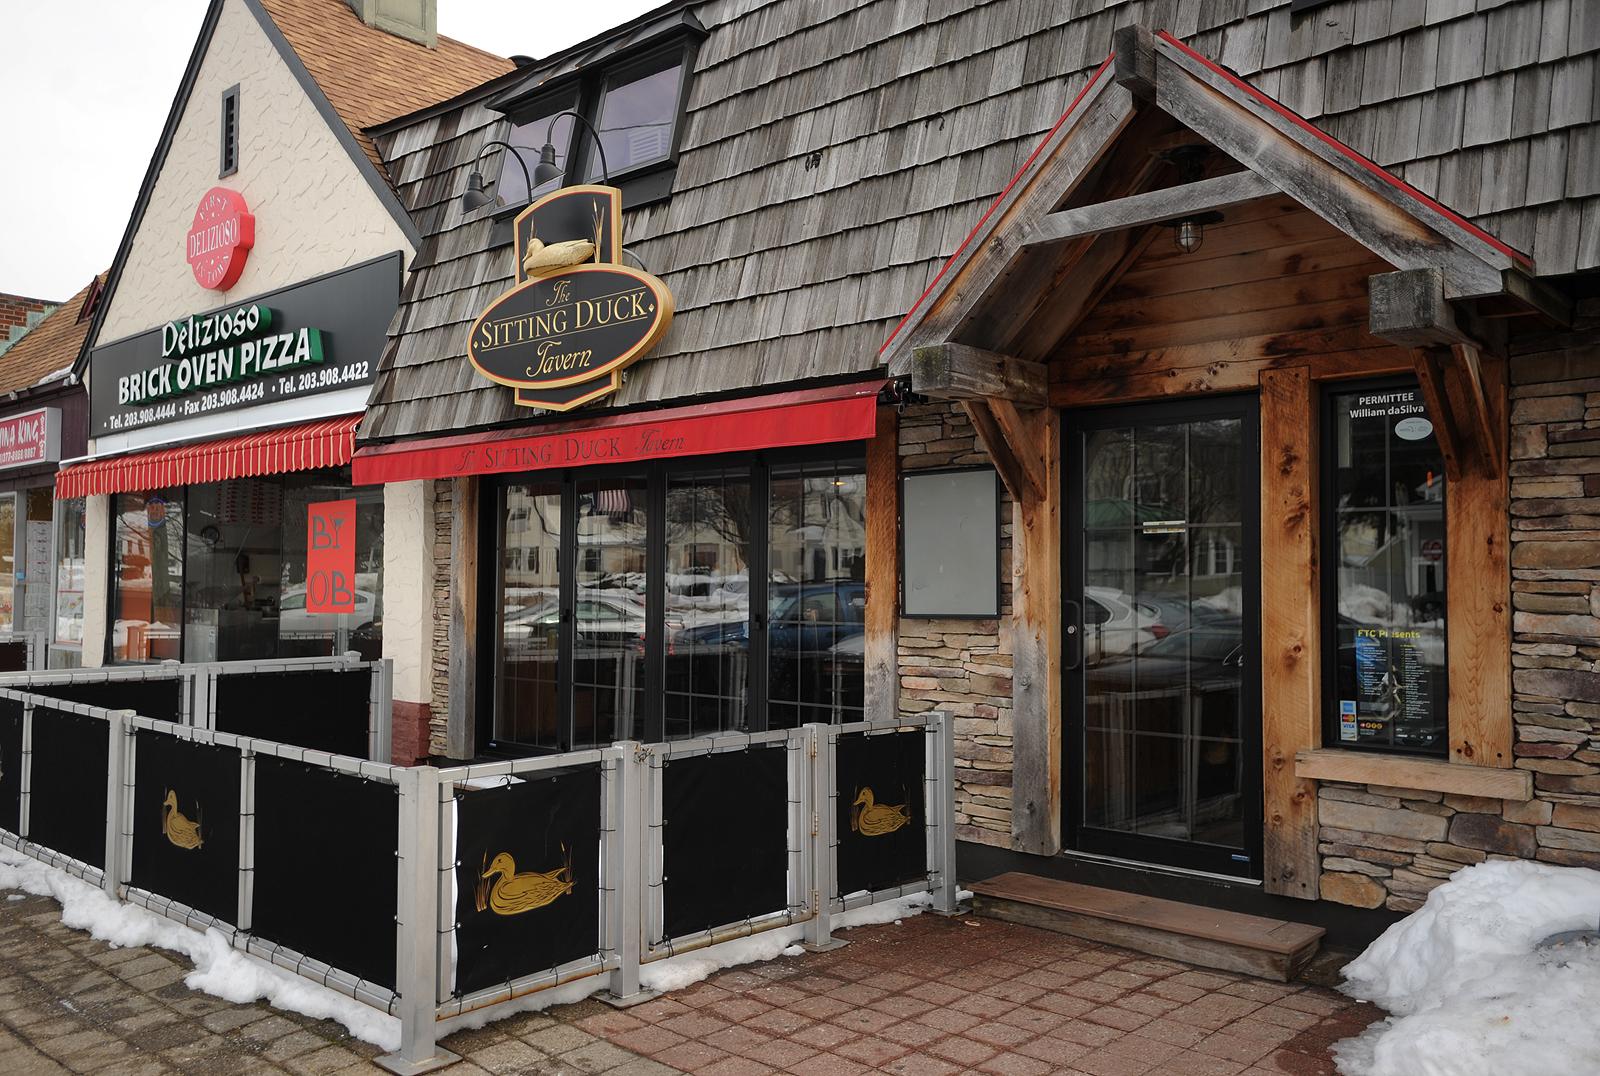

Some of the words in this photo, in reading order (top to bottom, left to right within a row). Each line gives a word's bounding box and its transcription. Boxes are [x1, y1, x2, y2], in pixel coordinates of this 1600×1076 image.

[189, 217, 238, 259] DELIZIOSO
[545, 279, 571, 307] The
[160, 303, 260, 359] Delizioso
[480, 309, 567, 349] SITTING
[574, 290, 647, 329] DUCK
[118, 362, 172, 405] BRICK
[176, 346, 234, 390] OVEN
[239, 327, 311, 376] PIZZA
[525, 339, 592, 378] Tavern
[109, 413, 123, 429] Tel.
[123, 402, 176, 428] 203.908.4444
[183, 400, 200, 416] Fax
[200, 381, 265, 412] 203.908.4424
[278, 375, 297, 395] Tel.
[297, 360, 370, 391] 203.908.4422
[1349, 408, 1386, 419] William
[1387, 404, 1425, 416] daSilva
[1359, 392, 1415, 406] PERMITTEE
[18, 418, 39, 444] KING
[485, 443, 553, 469] SITTING
[564, 436, 622, 461] DUCK
[310, 570, 352, 606] OB
[1357, 629, 1376, 638] FTC
